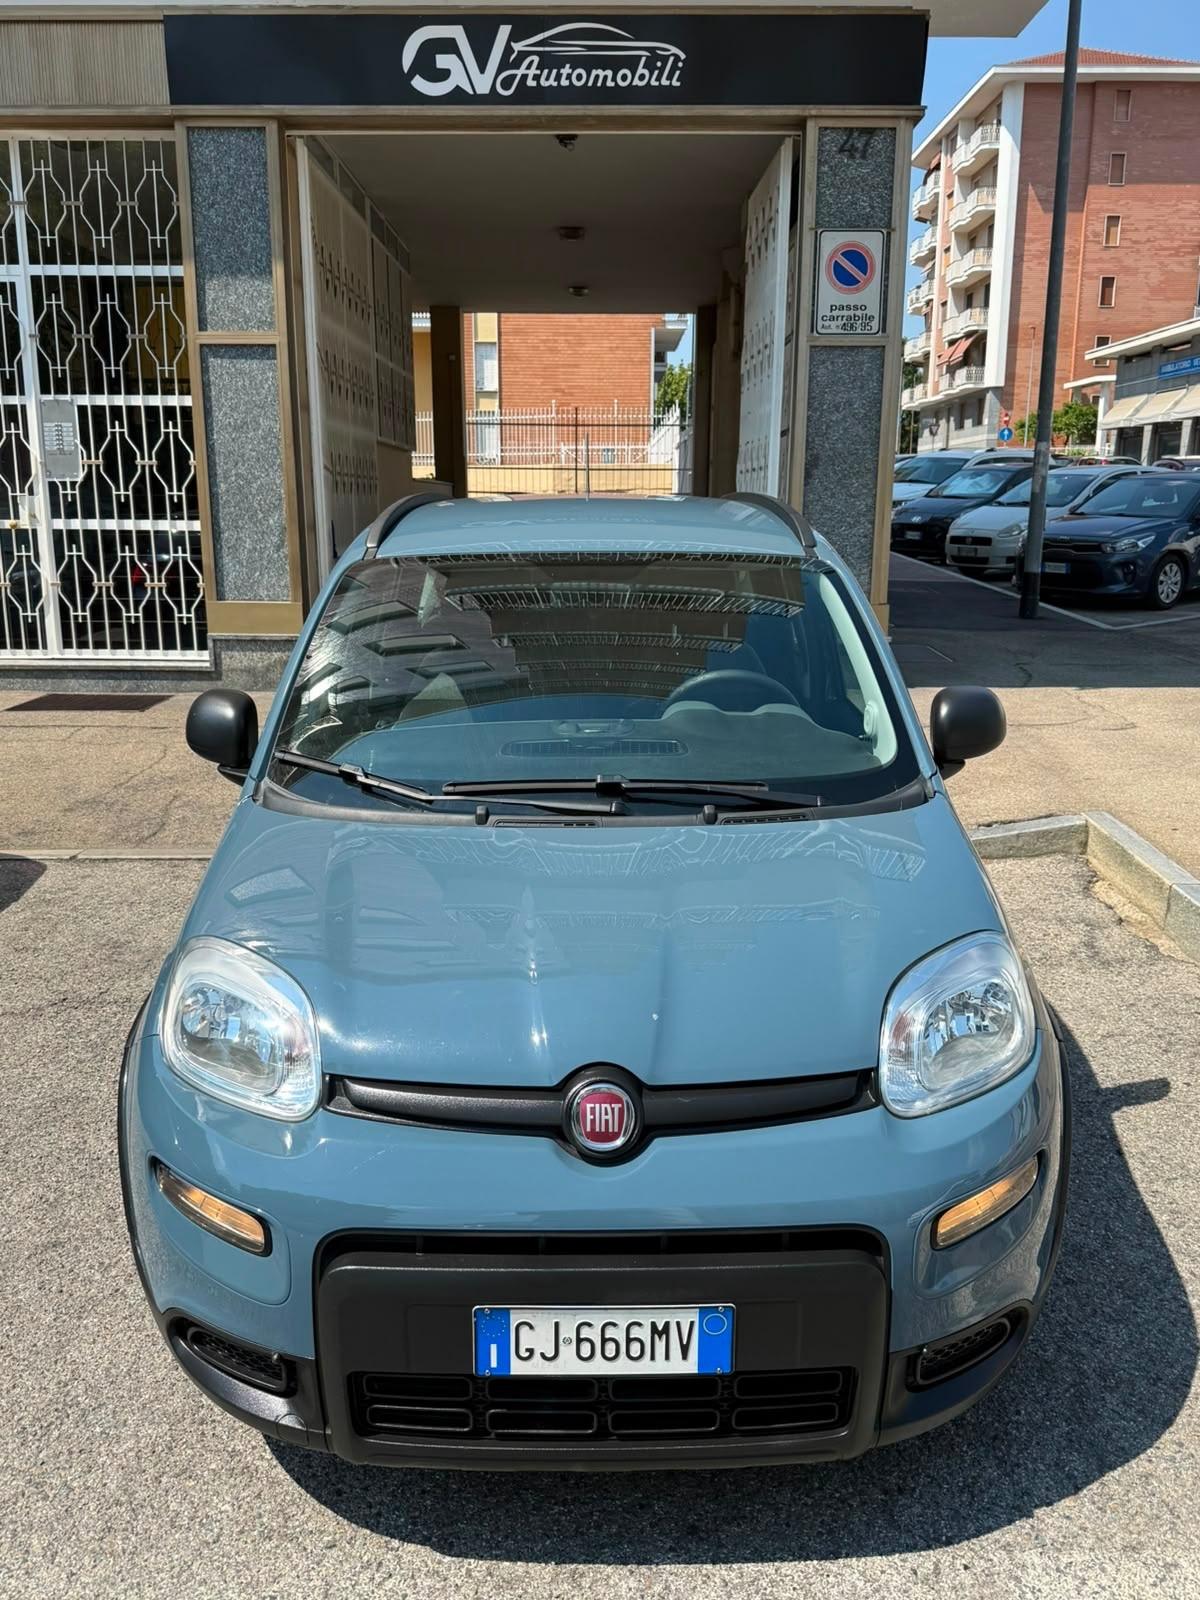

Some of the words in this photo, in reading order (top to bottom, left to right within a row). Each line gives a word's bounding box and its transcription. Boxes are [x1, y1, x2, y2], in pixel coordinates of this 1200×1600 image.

[402, 24, 512, 97] GV
[496, 54, 684, 97] Automobili
[838, 128, 877, 160] 47
[821, 313, 875, 322] carrabile
[830, 304, 868, 313] passo
[586, 1103, 622, 1133] FIAT
